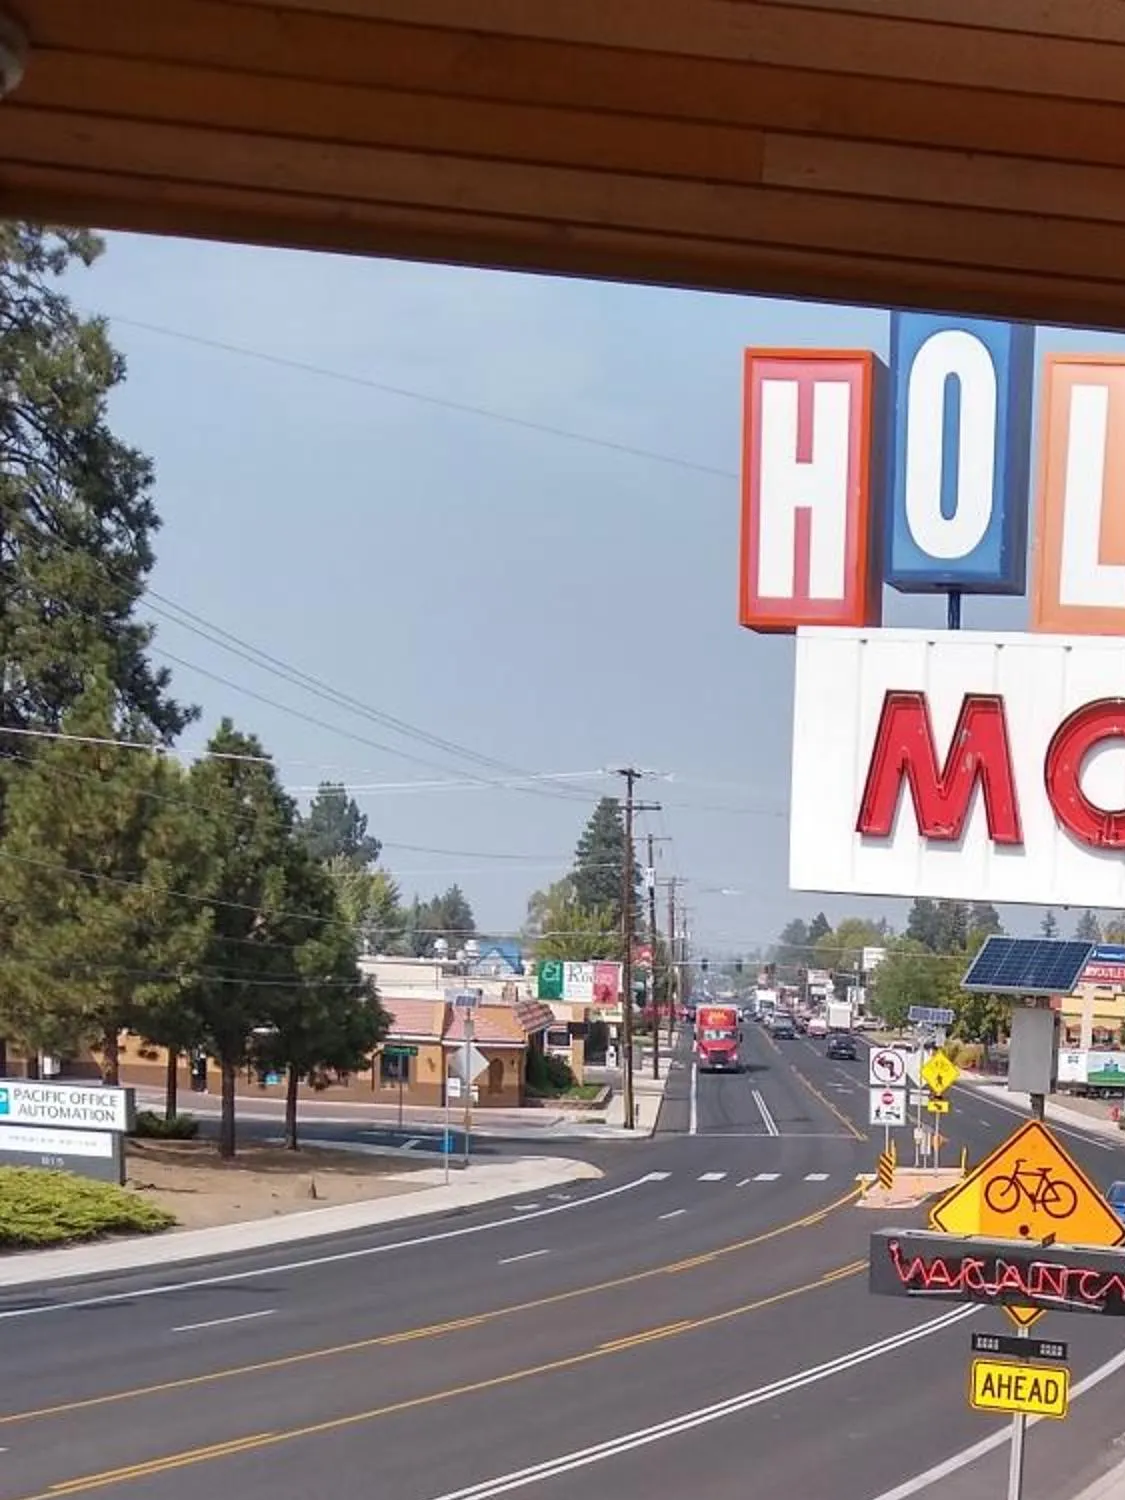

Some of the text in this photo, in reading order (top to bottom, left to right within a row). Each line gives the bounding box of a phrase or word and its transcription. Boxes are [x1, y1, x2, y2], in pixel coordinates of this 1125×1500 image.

[14, 1088, 118, 1107] PACIFIC OFFICE
[18, 1104, 115, 1122] AUTOMATION
[981, 1372, 1059, 1405] AHEAD
